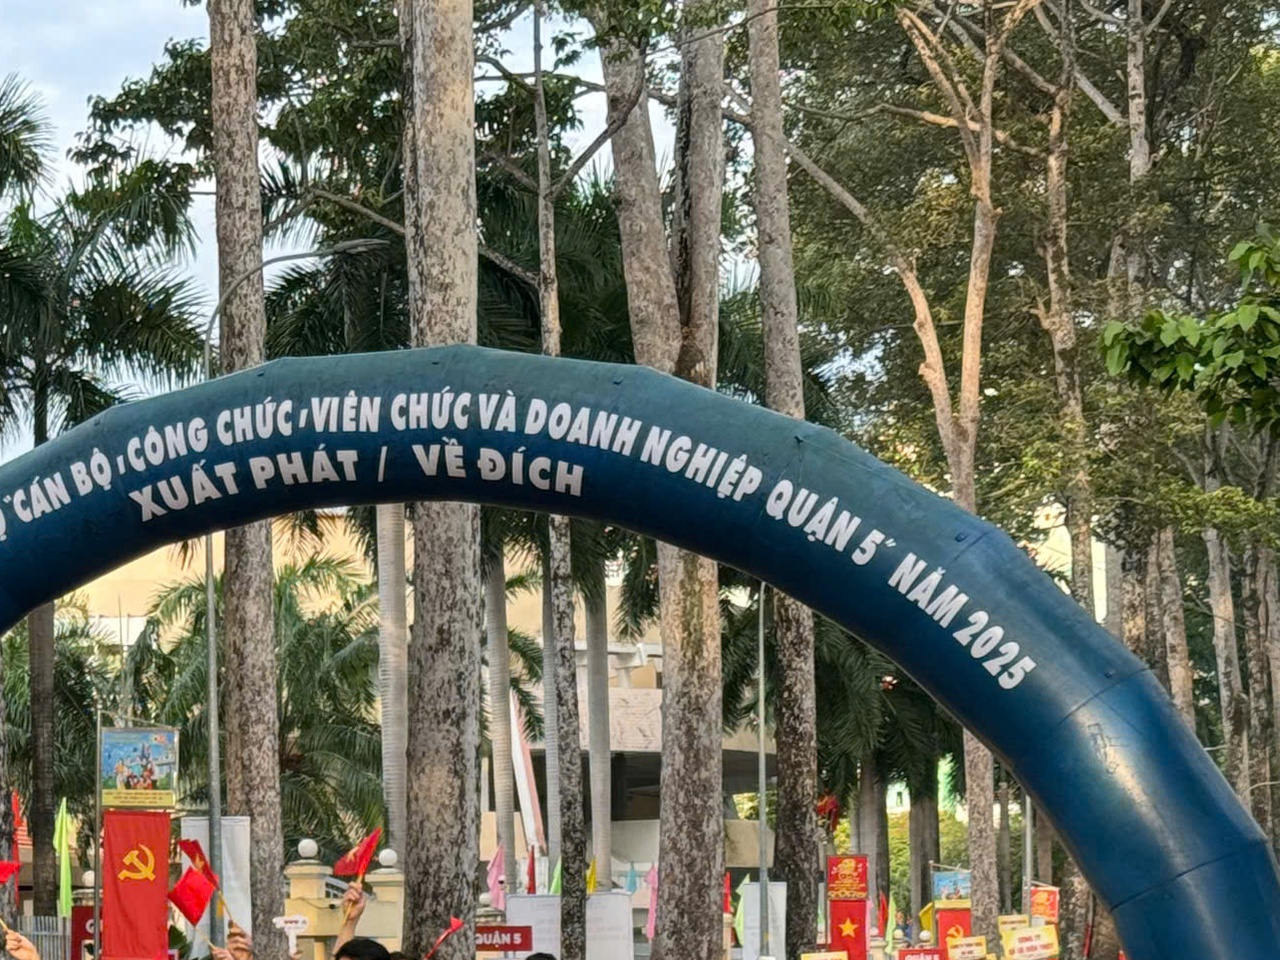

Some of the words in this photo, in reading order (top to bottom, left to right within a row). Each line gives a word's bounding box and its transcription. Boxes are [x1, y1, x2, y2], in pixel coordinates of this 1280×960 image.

[128, 458, 240, 523] XUẤT
[249, 443, 359, 490] PHÁT
[411, 435, 467, 479] VỀ
[477, 446, 585, 498] ĐÍCH
[390, 385, 472, 431] CHỨC
[478, 389, 516, 432] VÀ
[524, 398, 643, 457] DOANH
[640, 425, 764, 502] NGHIỆP
[765, 478, 863, 553] QUẬN
[887, 551, 970, 630] NĂM
[952, 610, 1038, 691] 2025
